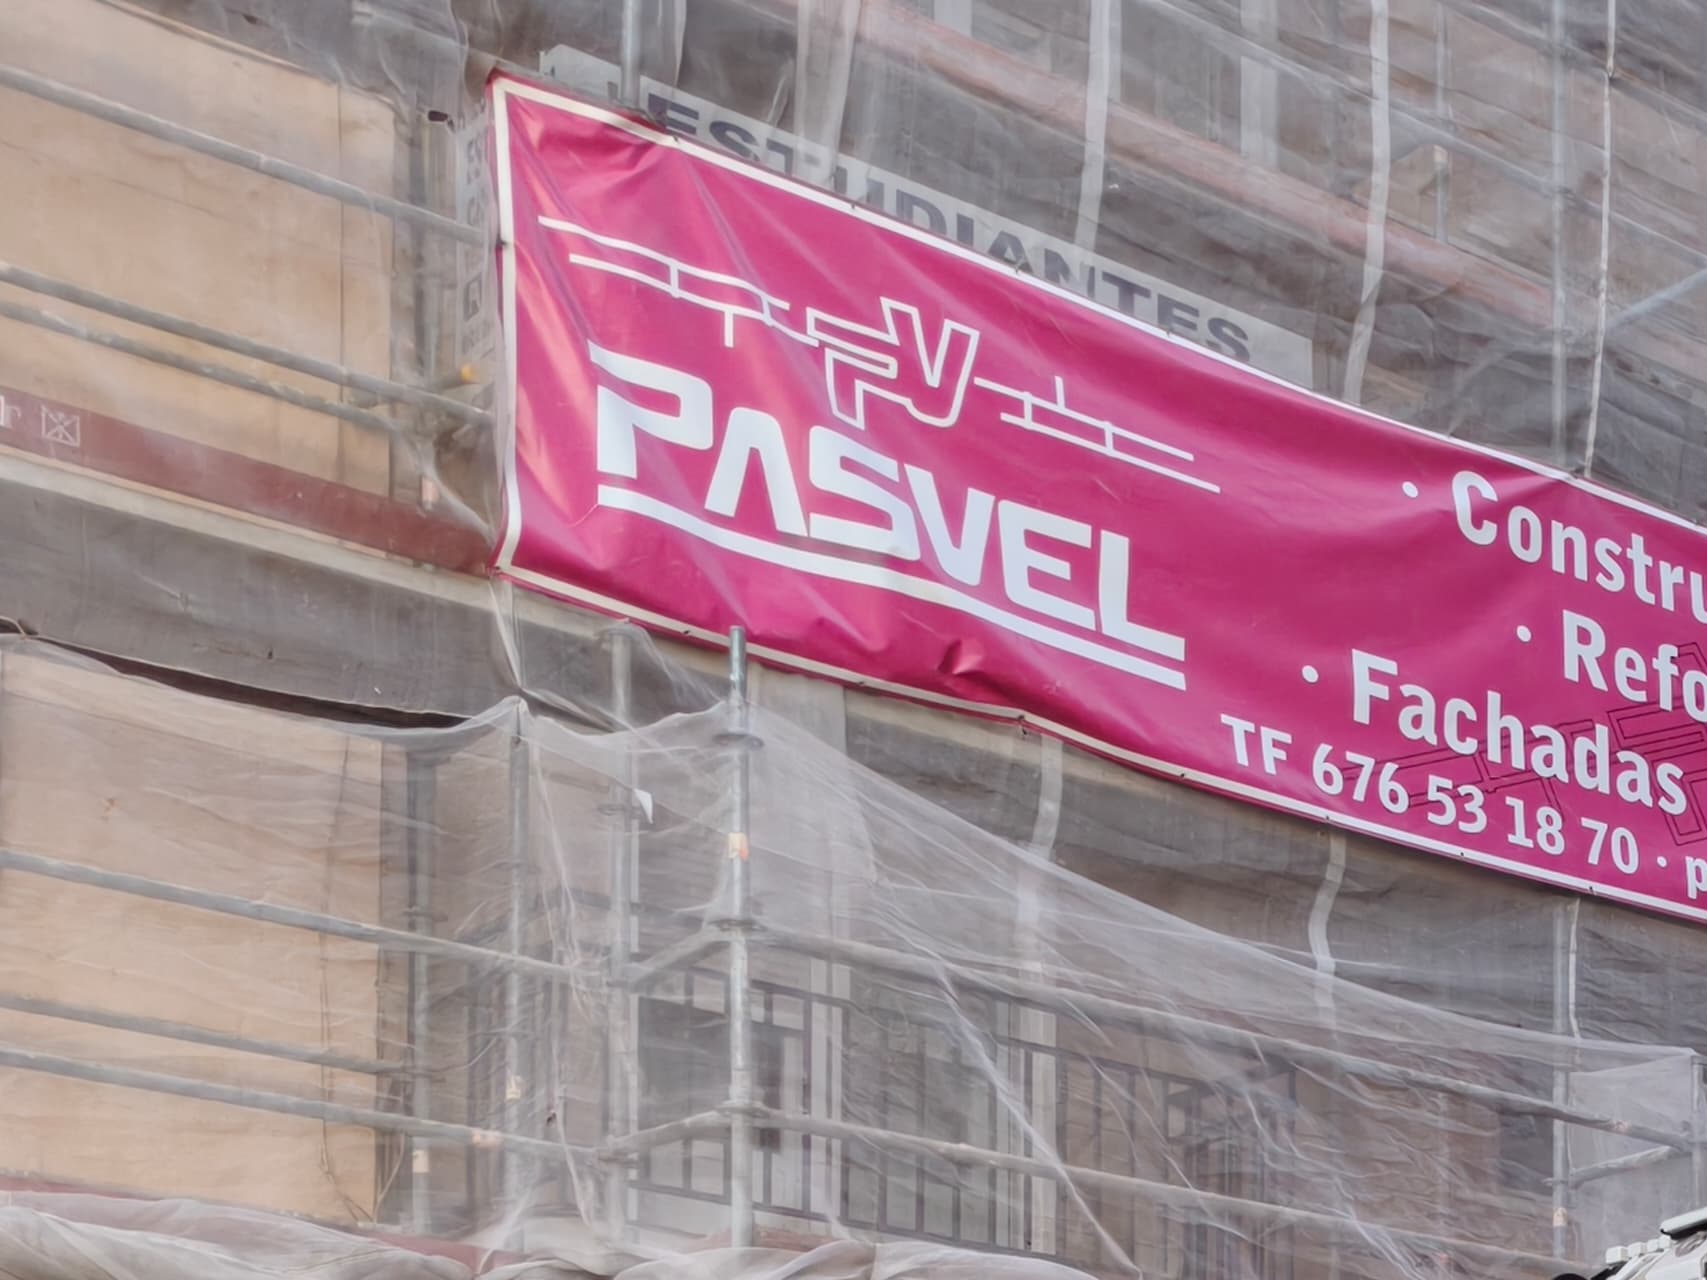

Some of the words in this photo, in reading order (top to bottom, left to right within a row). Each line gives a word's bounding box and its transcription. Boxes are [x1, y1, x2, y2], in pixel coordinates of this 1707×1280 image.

[645, 92, 1252, 364] ESTUDIANTES
[588, 339, 1186, 662] PASVEL
[1220, 712, 1293, 777] TF
[1311, 742, 1411, 815] 676
[1426, 774, 1489, 834] 53
[1504, 796, 1566, 857] 18
[1580, 816, 1640, 876] 70
[1351, 648, 1688, 817] Fachadas
